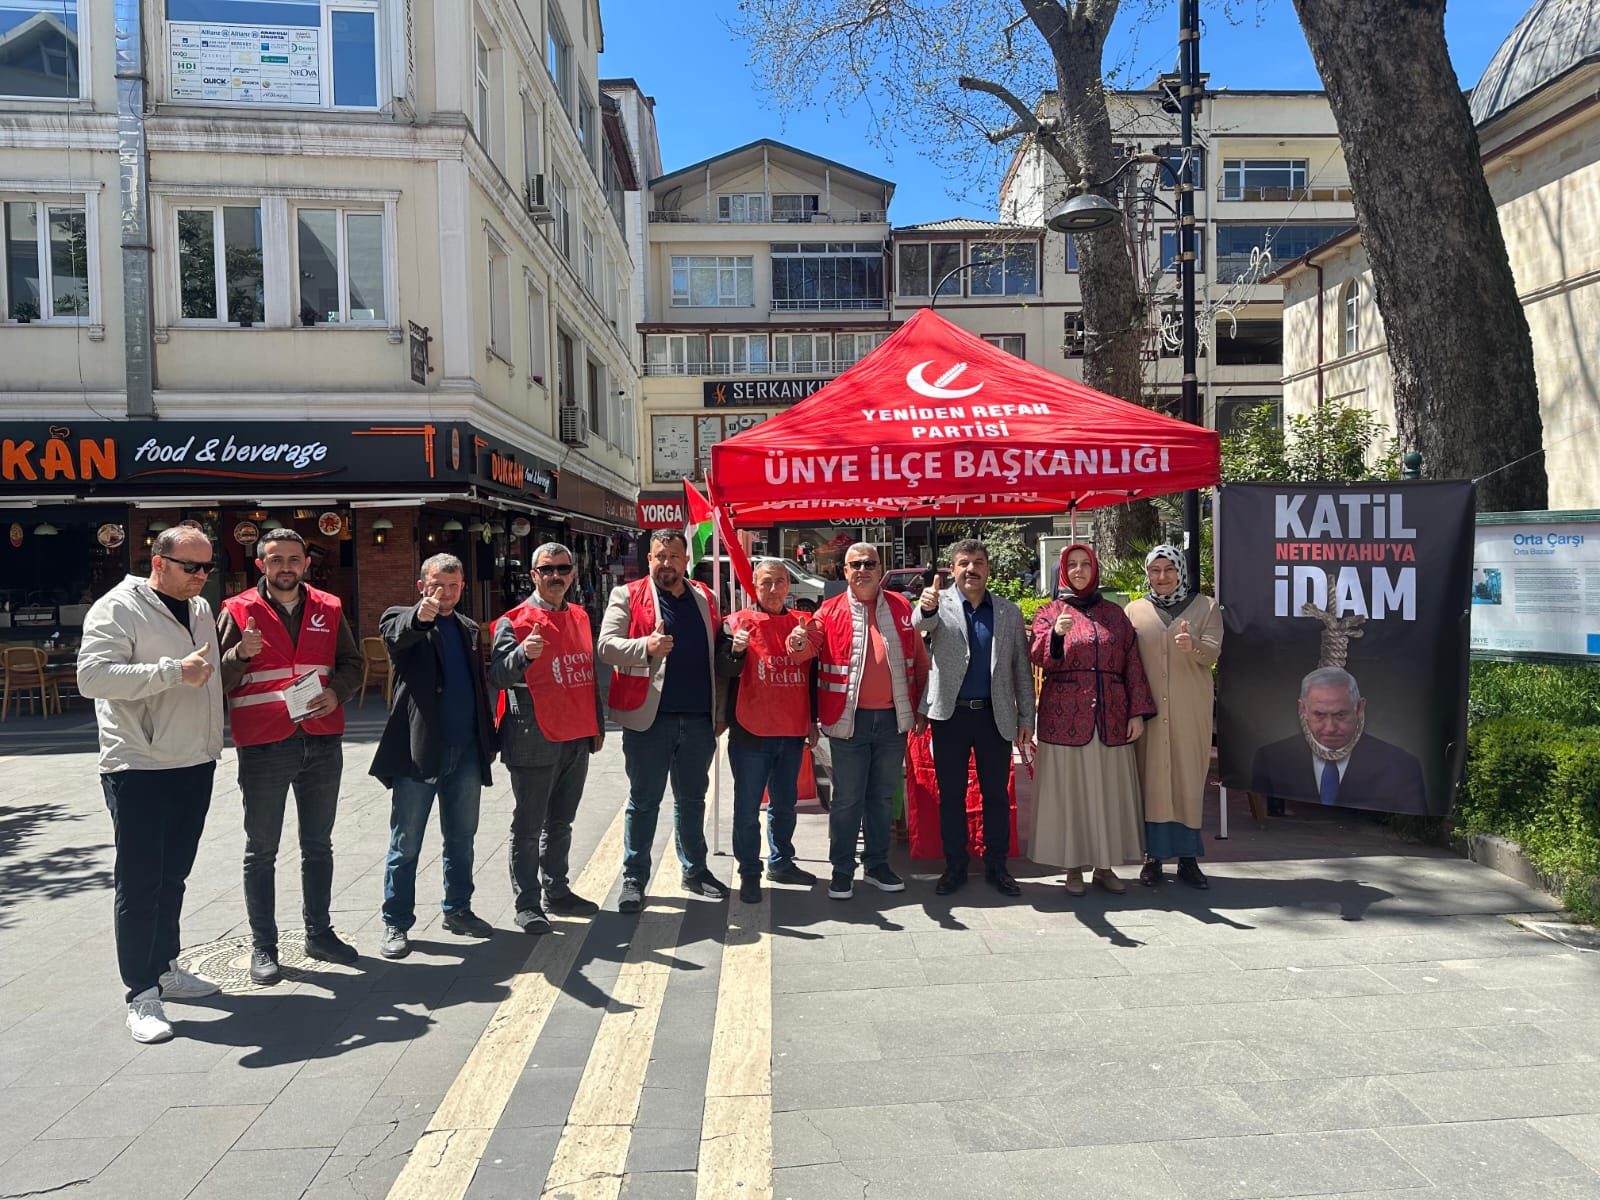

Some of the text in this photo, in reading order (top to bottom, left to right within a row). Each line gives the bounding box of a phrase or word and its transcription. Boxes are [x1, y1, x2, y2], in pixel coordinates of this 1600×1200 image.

[231, 30, 250, 38] Allianz
[177, 62, 197, 70] HDI
[290, 69, 317, 77] NEOVA
[203, 77, 226, 85] QUICK
[733, 381, 804, 399] SERKAN
[862, 403, 1051, 421] YENİDEN REFAH
[911, 420, 1010, 439] PARTİSİ
[134, 434, 328, 469] food & beverage
[764, 445, 1170, 488] ÜNYE İLÇE BAŞKANLIĞI
[1513, 532, 1585, 548] Orta Çarşı
[1275, 542, 1416, 562] NETENYAHU'YA
[1513, 548, 1529, 556] Orta
